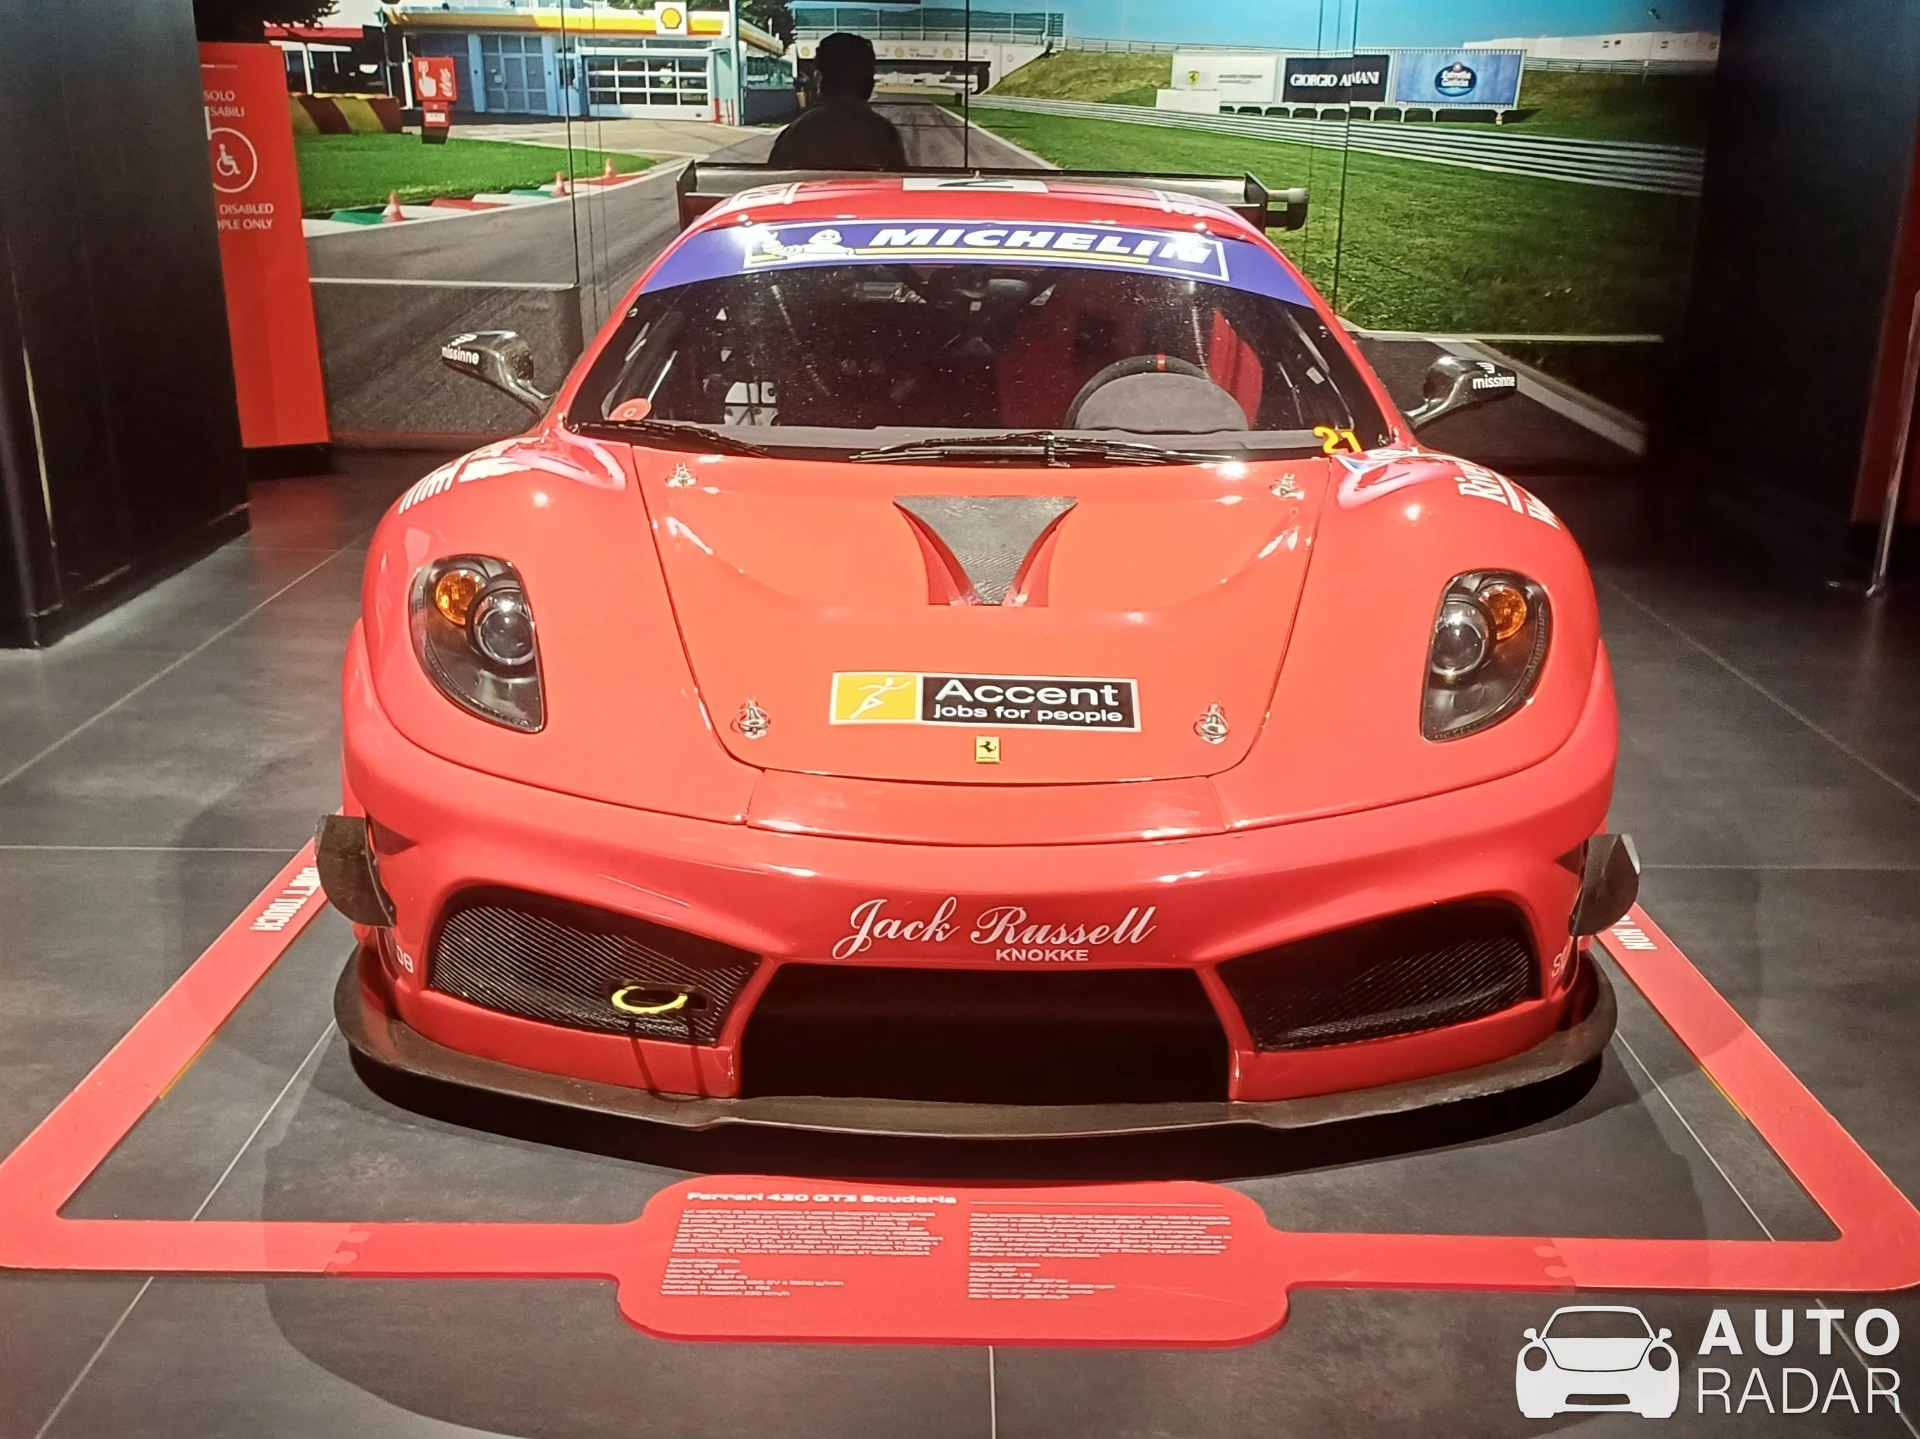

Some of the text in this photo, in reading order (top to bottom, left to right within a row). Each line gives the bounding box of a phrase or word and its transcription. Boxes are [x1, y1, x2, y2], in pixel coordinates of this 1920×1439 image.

[1290, 73, 1338, 87] GIORGIO
[203, 90, 235, 101] SOLO
[210, 106, 245, 117] SABILI
[219, 203, 275, 215] DISABLED
[243, 218, 273, 230] ONLY
[868, 228, 1212, 264] MICHELIN
[1313, 426, 1362, 454] 21
[934, 679, 1120, 706] Accent
[934, 703, 1123, 724] jobs for people
[832, 896, 1158, 960] Jack Russell
[996, 949, 1089, 962] KNOKKE
[687, 1191, 765, 1202] Ferrari
[860, 1194, 958, 1205] Scuderia
